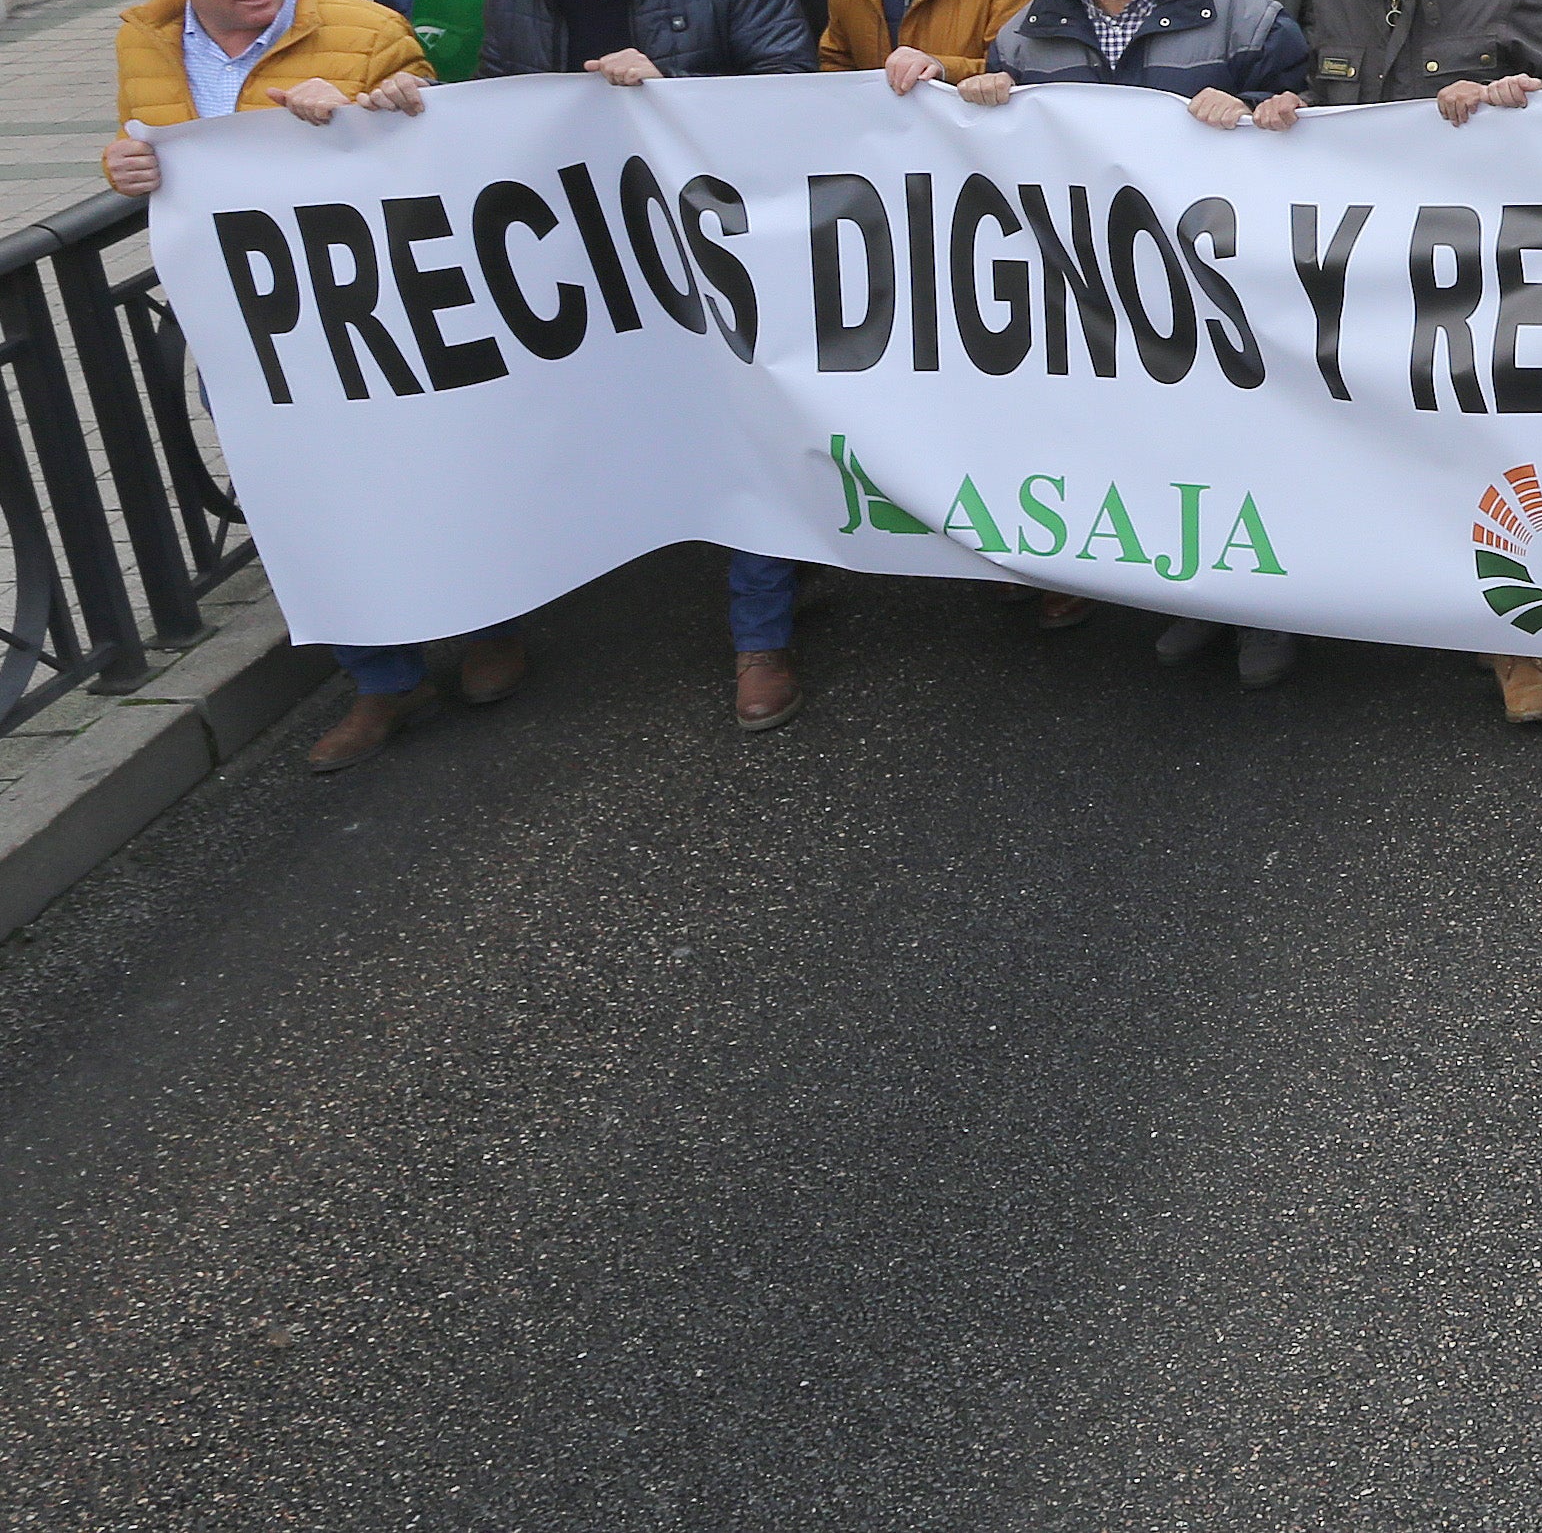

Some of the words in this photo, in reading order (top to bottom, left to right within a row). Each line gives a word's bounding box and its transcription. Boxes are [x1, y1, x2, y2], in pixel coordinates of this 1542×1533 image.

[212, 154, 759, 405] PRECIOS
[807, 171, 1266, 390] DIGNOS
[1290, 204, 1376, 402] Y
[942, 474, 1289, 583] ASAJA
